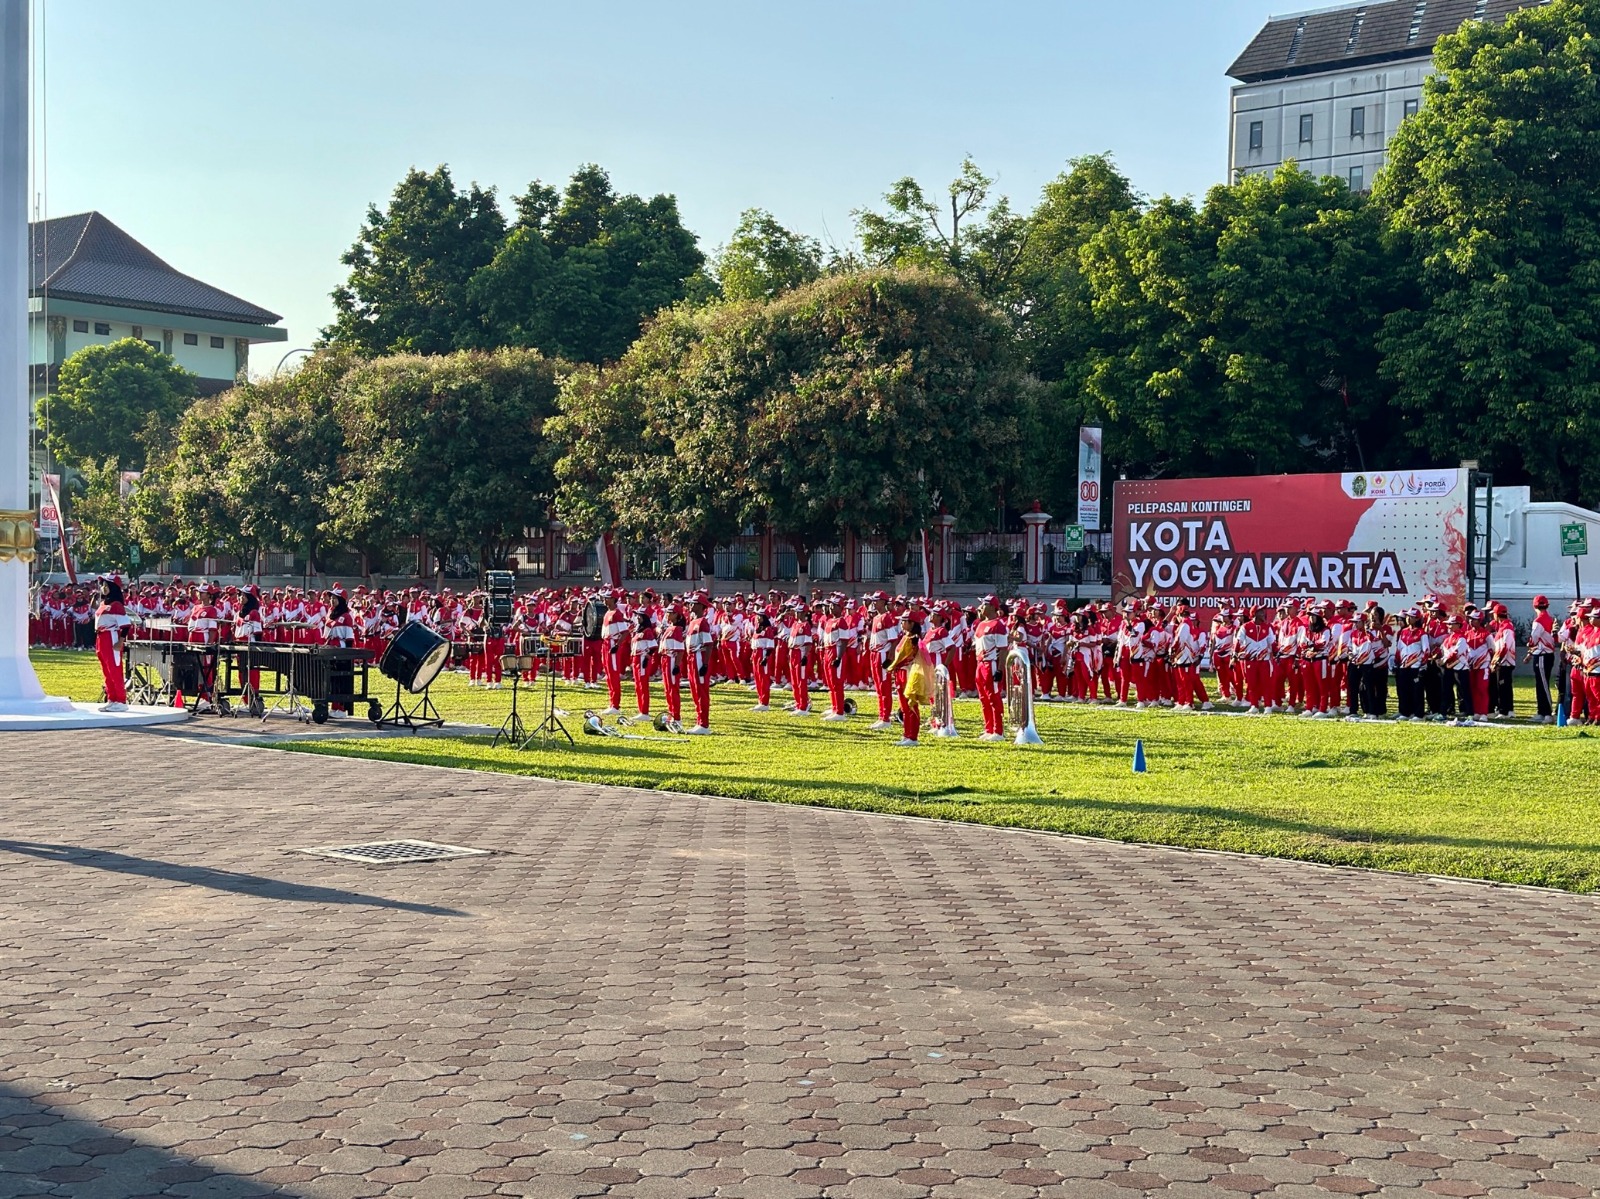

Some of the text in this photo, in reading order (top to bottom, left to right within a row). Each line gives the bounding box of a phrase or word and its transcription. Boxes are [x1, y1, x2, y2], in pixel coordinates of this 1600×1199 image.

[1081, 481, 1098, 501] 80
[1128, 500, 1251, 514] PELEPASAN KONTINGEN
[1130, 521, 1230, 551] KOTA
[1129, 557, 1401, 588] YOGYAKARTA
